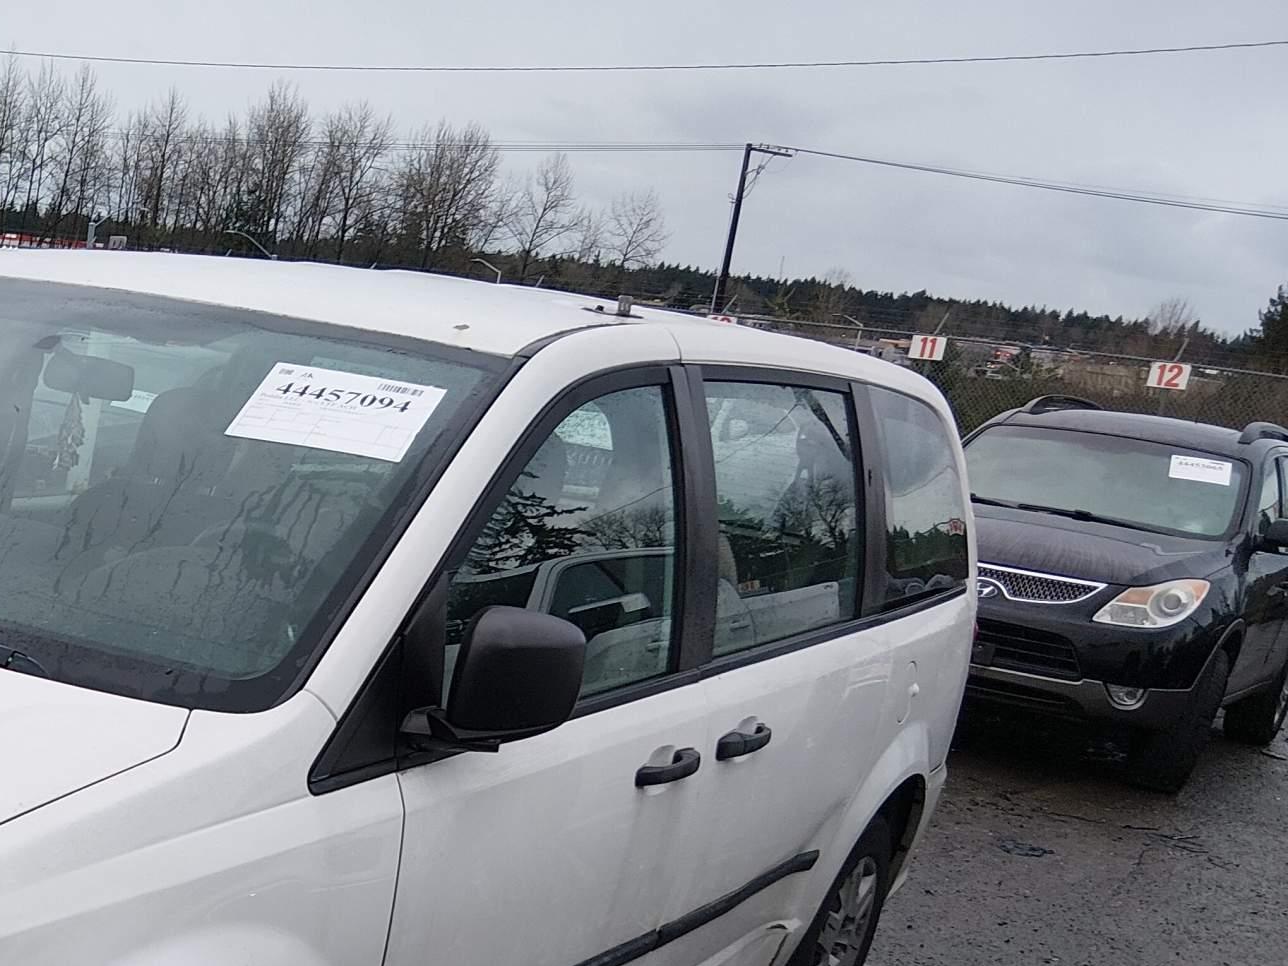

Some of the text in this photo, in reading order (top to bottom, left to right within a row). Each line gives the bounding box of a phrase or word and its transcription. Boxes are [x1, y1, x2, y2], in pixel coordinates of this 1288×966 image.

[919, 336, 938, 358] 11
[1156, 363, 1184, 387] 12
[276, 381, 412, 413] 44457094
